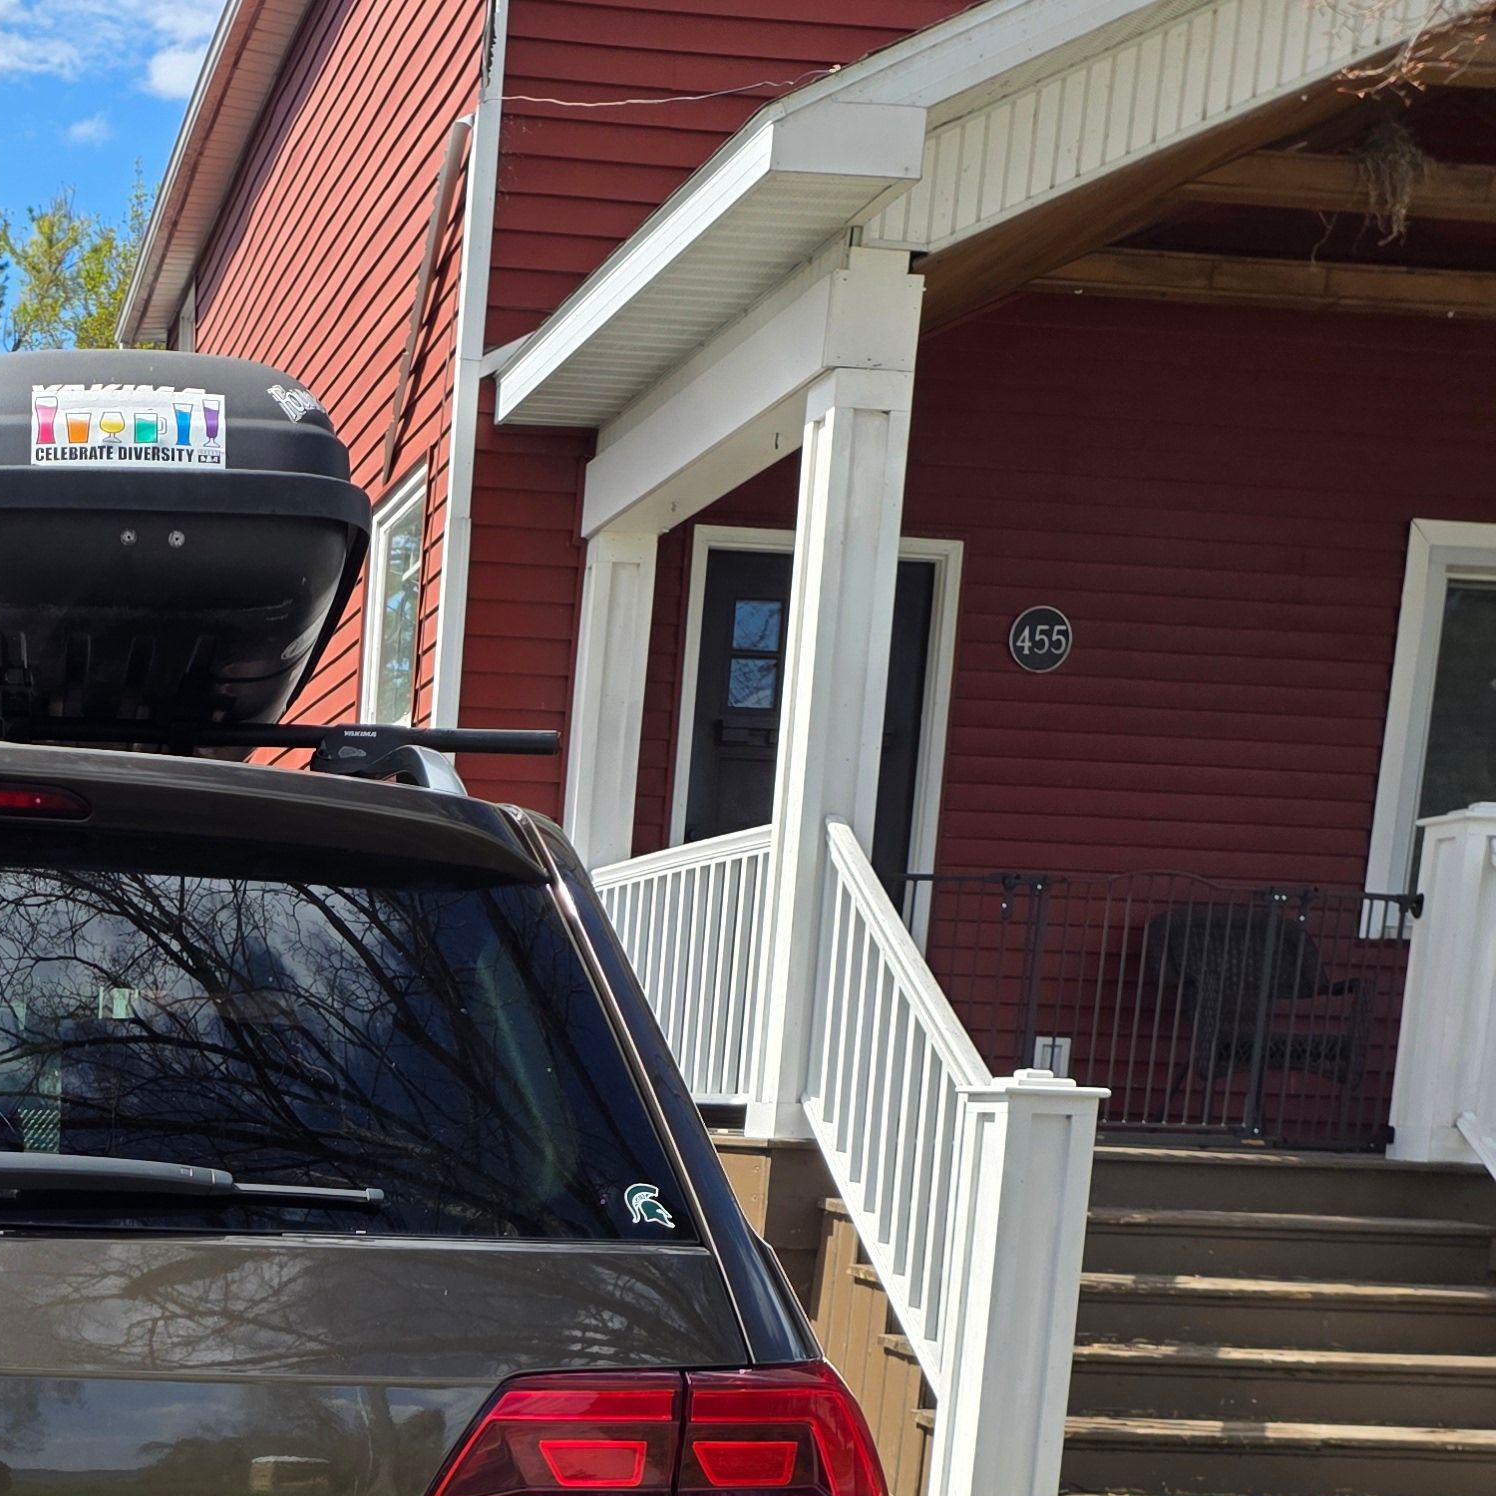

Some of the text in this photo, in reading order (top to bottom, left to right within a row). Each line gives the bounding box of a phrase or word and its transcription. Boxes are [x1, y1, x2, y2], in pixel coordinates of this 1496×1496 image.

[35, 445, 114, 462] CELEBRATE
[118, 446, 194, 463] DIVERSITY
[1015, 624, 1067, 655] 455
[343, 730, 377, 738] YAKIMA
